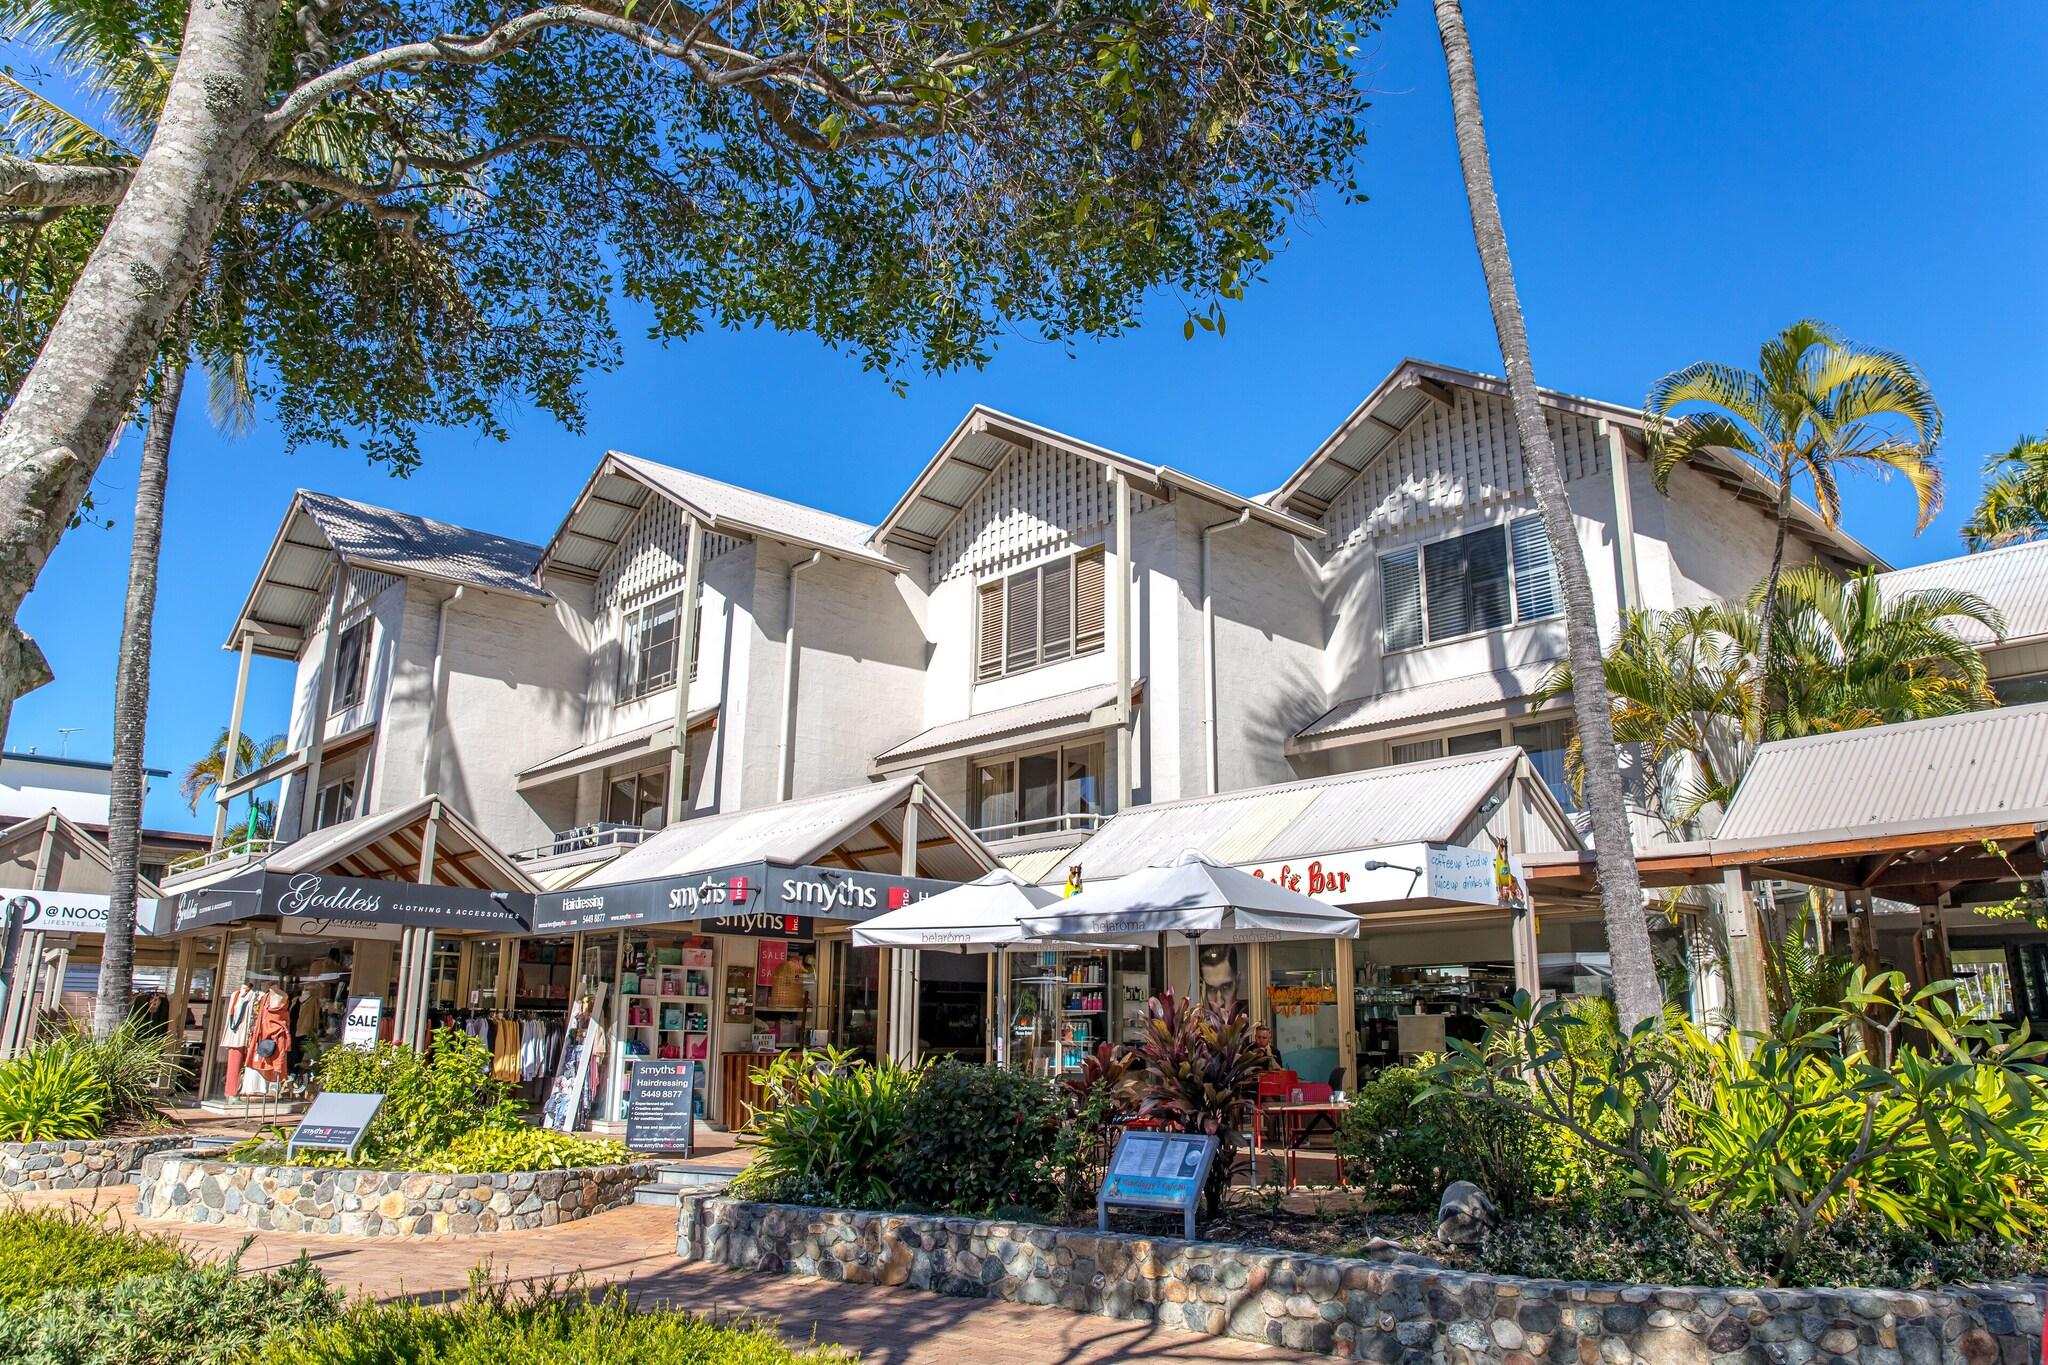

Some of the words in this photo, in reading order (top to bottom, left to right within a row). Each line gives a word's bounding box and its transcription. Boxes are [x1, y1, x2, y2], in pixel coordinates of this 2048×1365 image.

[1307, 861, 1350, 897] Bar
[278, 873, 381, 915] Goddess
[669, 876, 727, 914] smyths
[781, 878, 877, 911] smyths
[562, 895, 604, 911] Hairdressing
[45, 906, 59, 917] @
[62, 907, 110, 920] NOOS
[393, 904, 441, 914] CLOTHING
[456, 909, 520, 919] ACCESSORIES
[716, 913, 783, 932] smyths
[762, 950, 785, 960] SALE
[348, 1015, 377, 1027] SALE
[640, 1065, 676, 1076] smyths
[637, 1079, 689, 1088] Hairdressing
